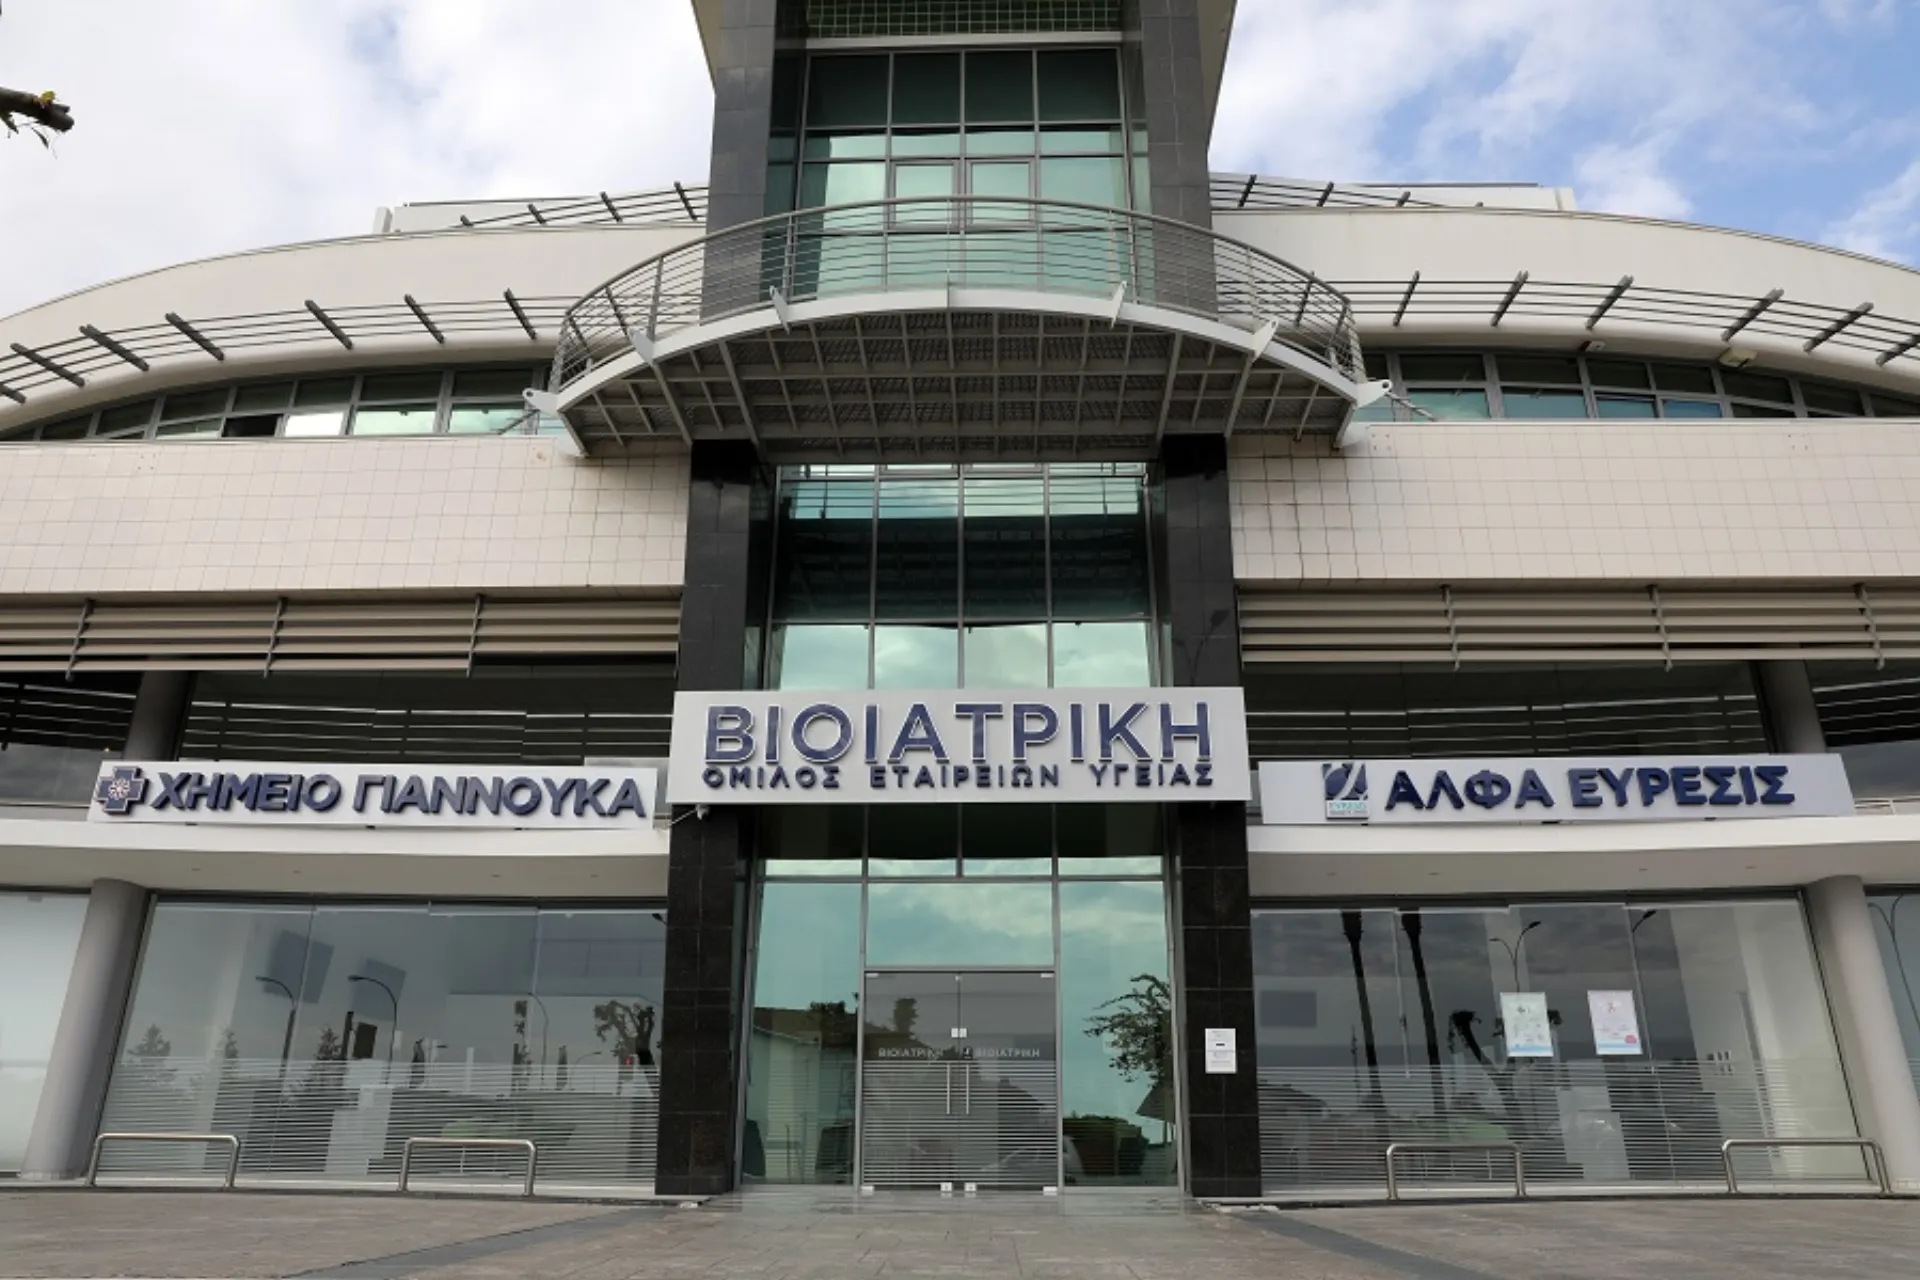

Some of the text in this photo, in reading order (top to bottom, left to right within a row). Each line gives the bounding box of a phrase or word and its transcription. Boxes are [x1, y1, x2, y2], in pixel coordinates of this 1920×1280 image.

[704, 700, 1212, 763] ΒΙΟΙΑΤΡΙΚΗ
[153, 771, 646, 818] ΧΗΜΕΙΟ ΓΙΑΝΝΟΥΚΑ
[701, 764, 1214, 789] ΟΜΙΛΟΣ ΕΤΑΙΡΕΙΩΝ ΥΓΕΙΑΣ
[1385, 765, 1796, 811] ΑΛΦΑ ΕΥΡΕΣΙΣ
